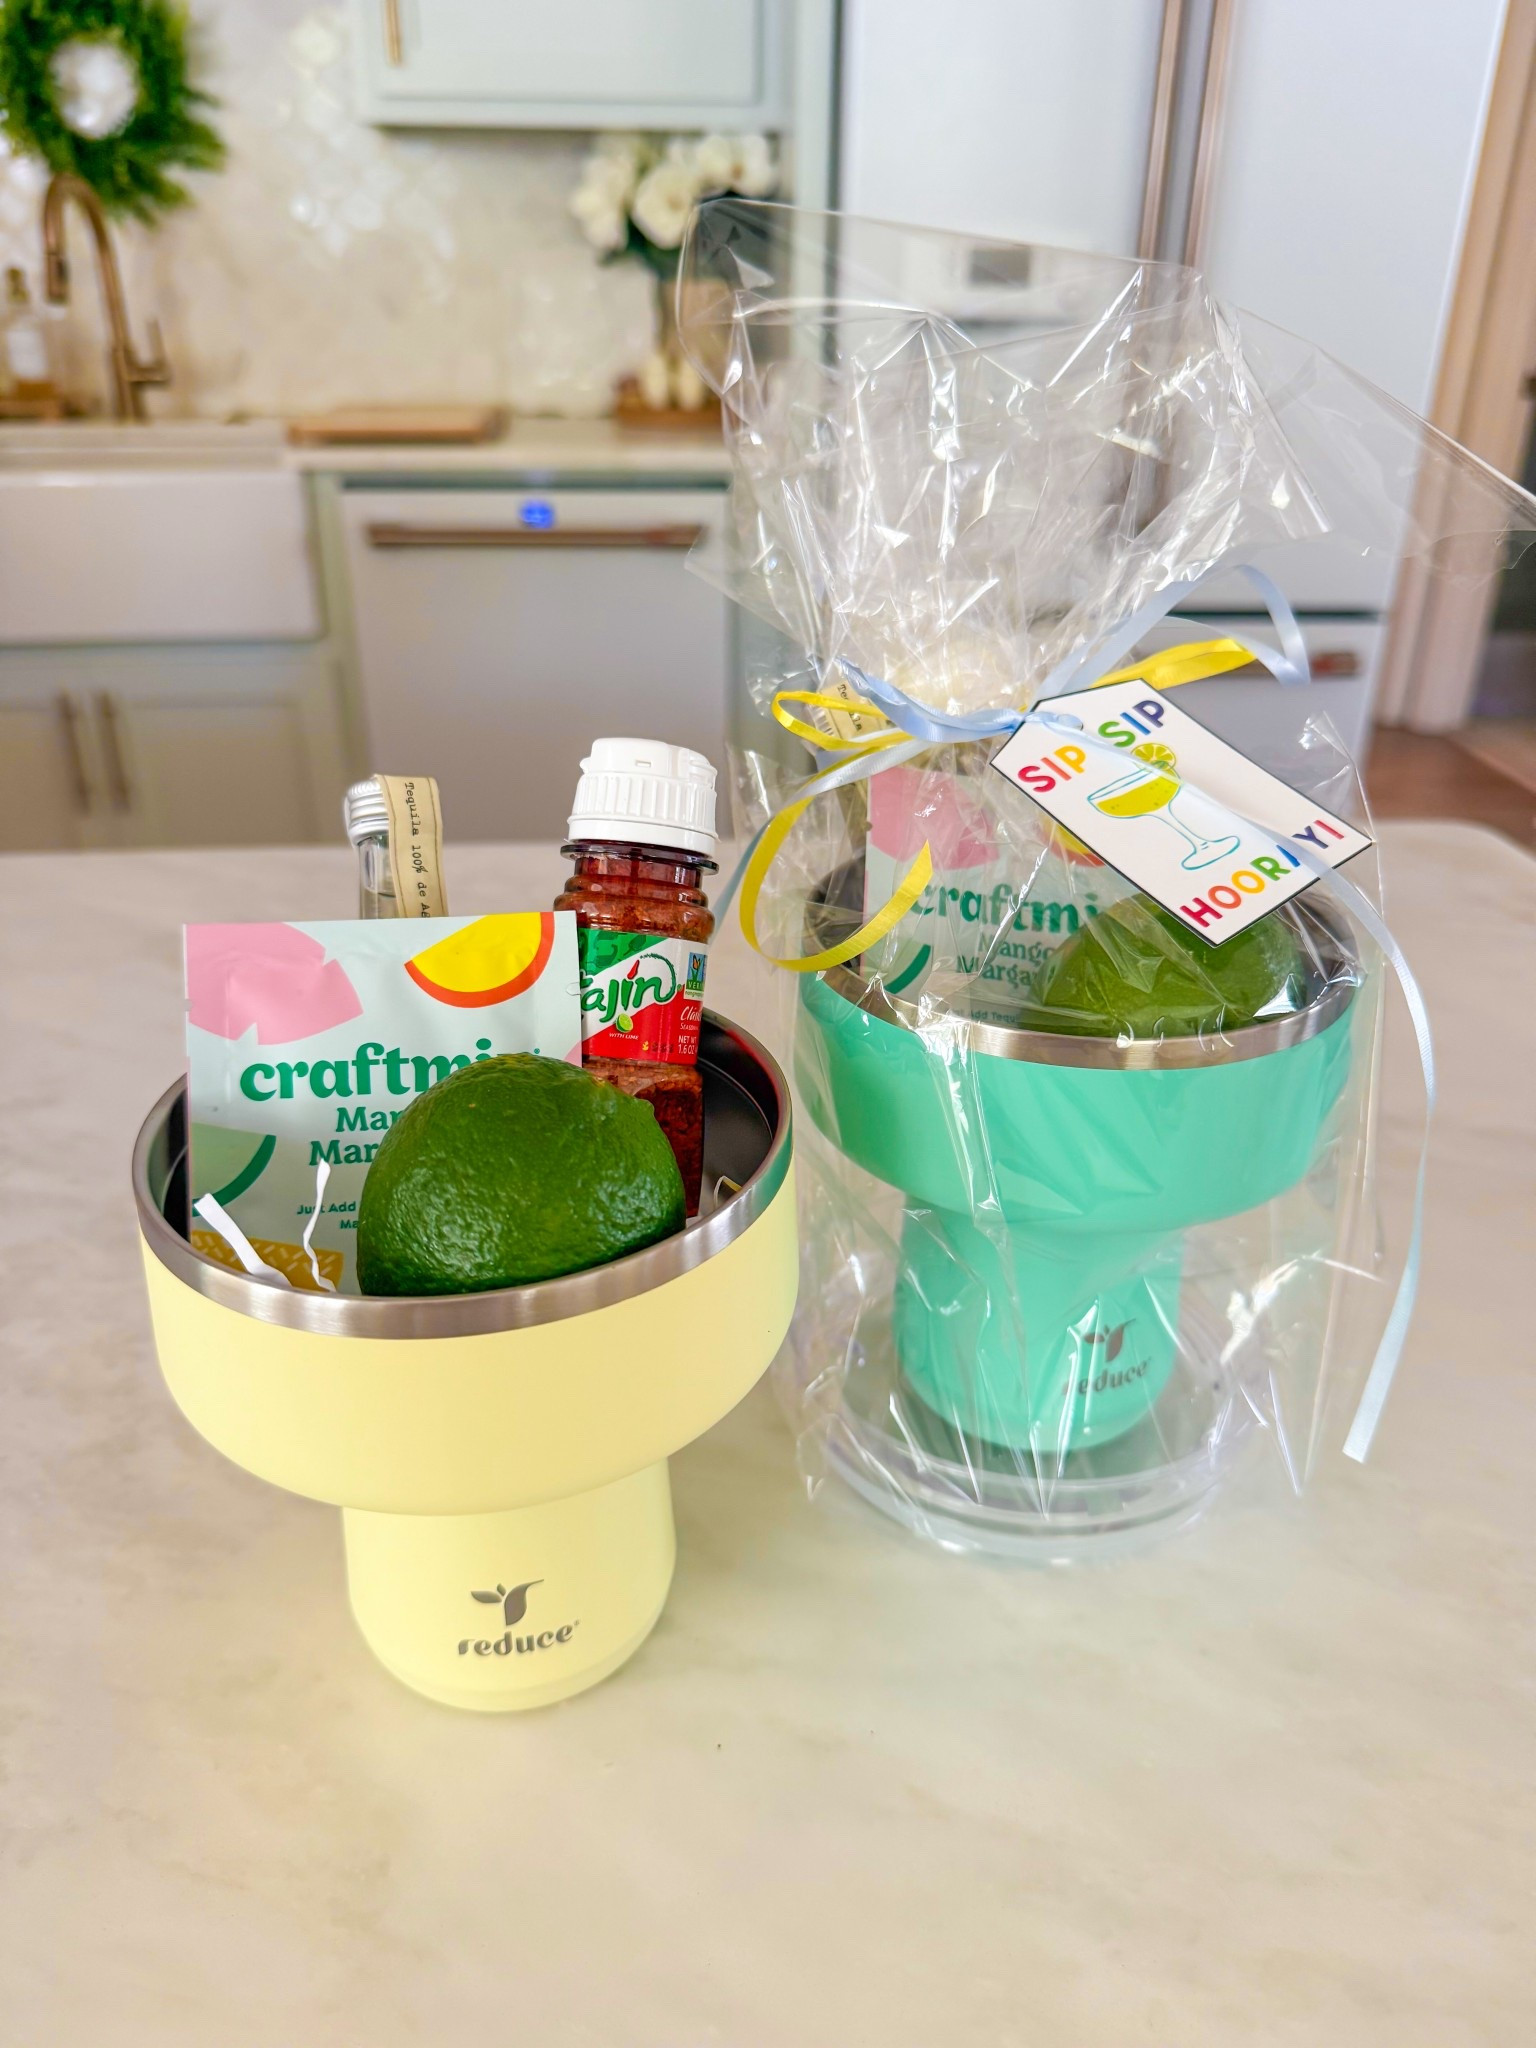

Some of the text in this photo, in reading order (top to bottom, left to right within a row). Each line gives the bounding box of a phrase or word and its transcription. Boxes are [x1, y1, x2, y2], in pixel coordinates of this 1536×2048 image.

[1017, 699, 1165, 793] SIP SIP
[405, 782, 421, 836] Tequila
[412, 845, 428, 874] 100%
[418, 882, 427, 897] de
[956, 955, 1038, 989] Marga
[678, 1035, 690, 1044] NET
[678, 1044, 687, 1054] 1.6
[240, 1038, 492, 1102] craftmi
[309, 1139, 379, 1166] Mar
[328, 1201, 356, 1213] Add
[458, 1624, 573, 1656] reduce
